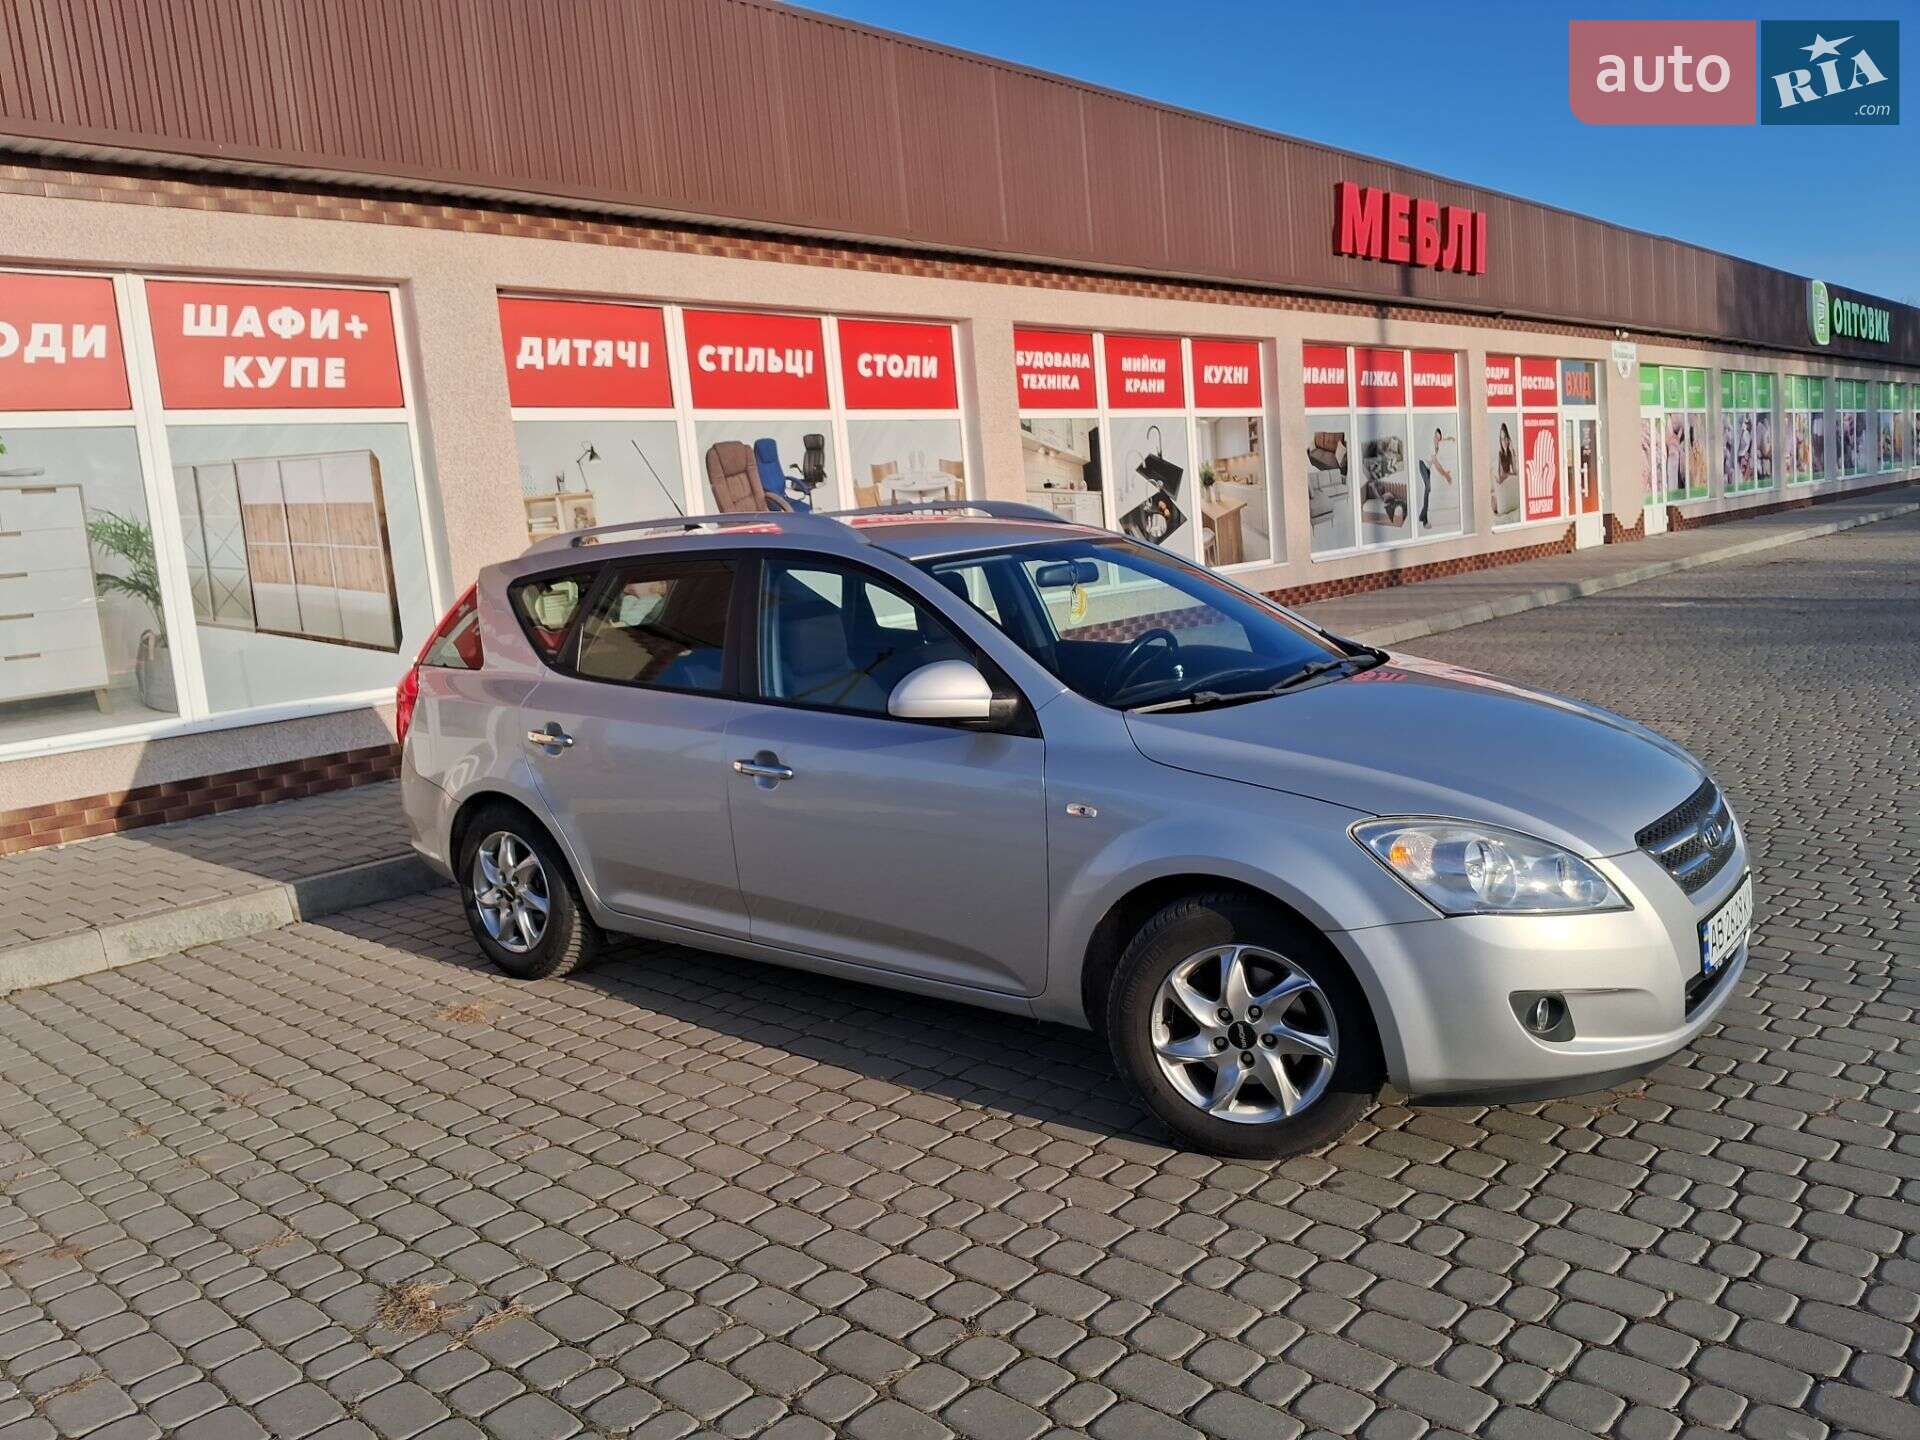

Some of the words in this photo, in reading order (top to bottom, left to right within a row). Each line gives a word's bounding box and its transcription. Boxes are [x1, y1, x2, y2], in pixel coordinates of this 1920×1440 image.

[1338, 181, 1487, 275] МЕБЛІ
[182, 303, 369, 340] ШАФИ+
[1833, 297, 1890, 343] ОПТОВИК
[516, 336, 650, 371] ДИТЯЧІ
[697, 344, 814, 378] СТІЛЬЦІ
[1015, 350, 1090, 369] БУДОВАНА
[1121, 355, 1166, 373] МИЙКИ
[222, 355, 347, 389] КУПЕ
[857, 352, 938, 379] СТОЛИ
[1203, 365, 1249, 385] КУХНІ
[1021, 373, 1080, 391] ТЕХНІКА
[1125, 377, 1165, 394] КРАНИ
[1360, 370, 1398, 387] ЛІЖКА
[1413, 372, 1454, 388] МАТРАЦИ
[1522, 375, 1555, 390] ПОСТІЛЬ
[1565, 371, 1591, 399] ВХІД
